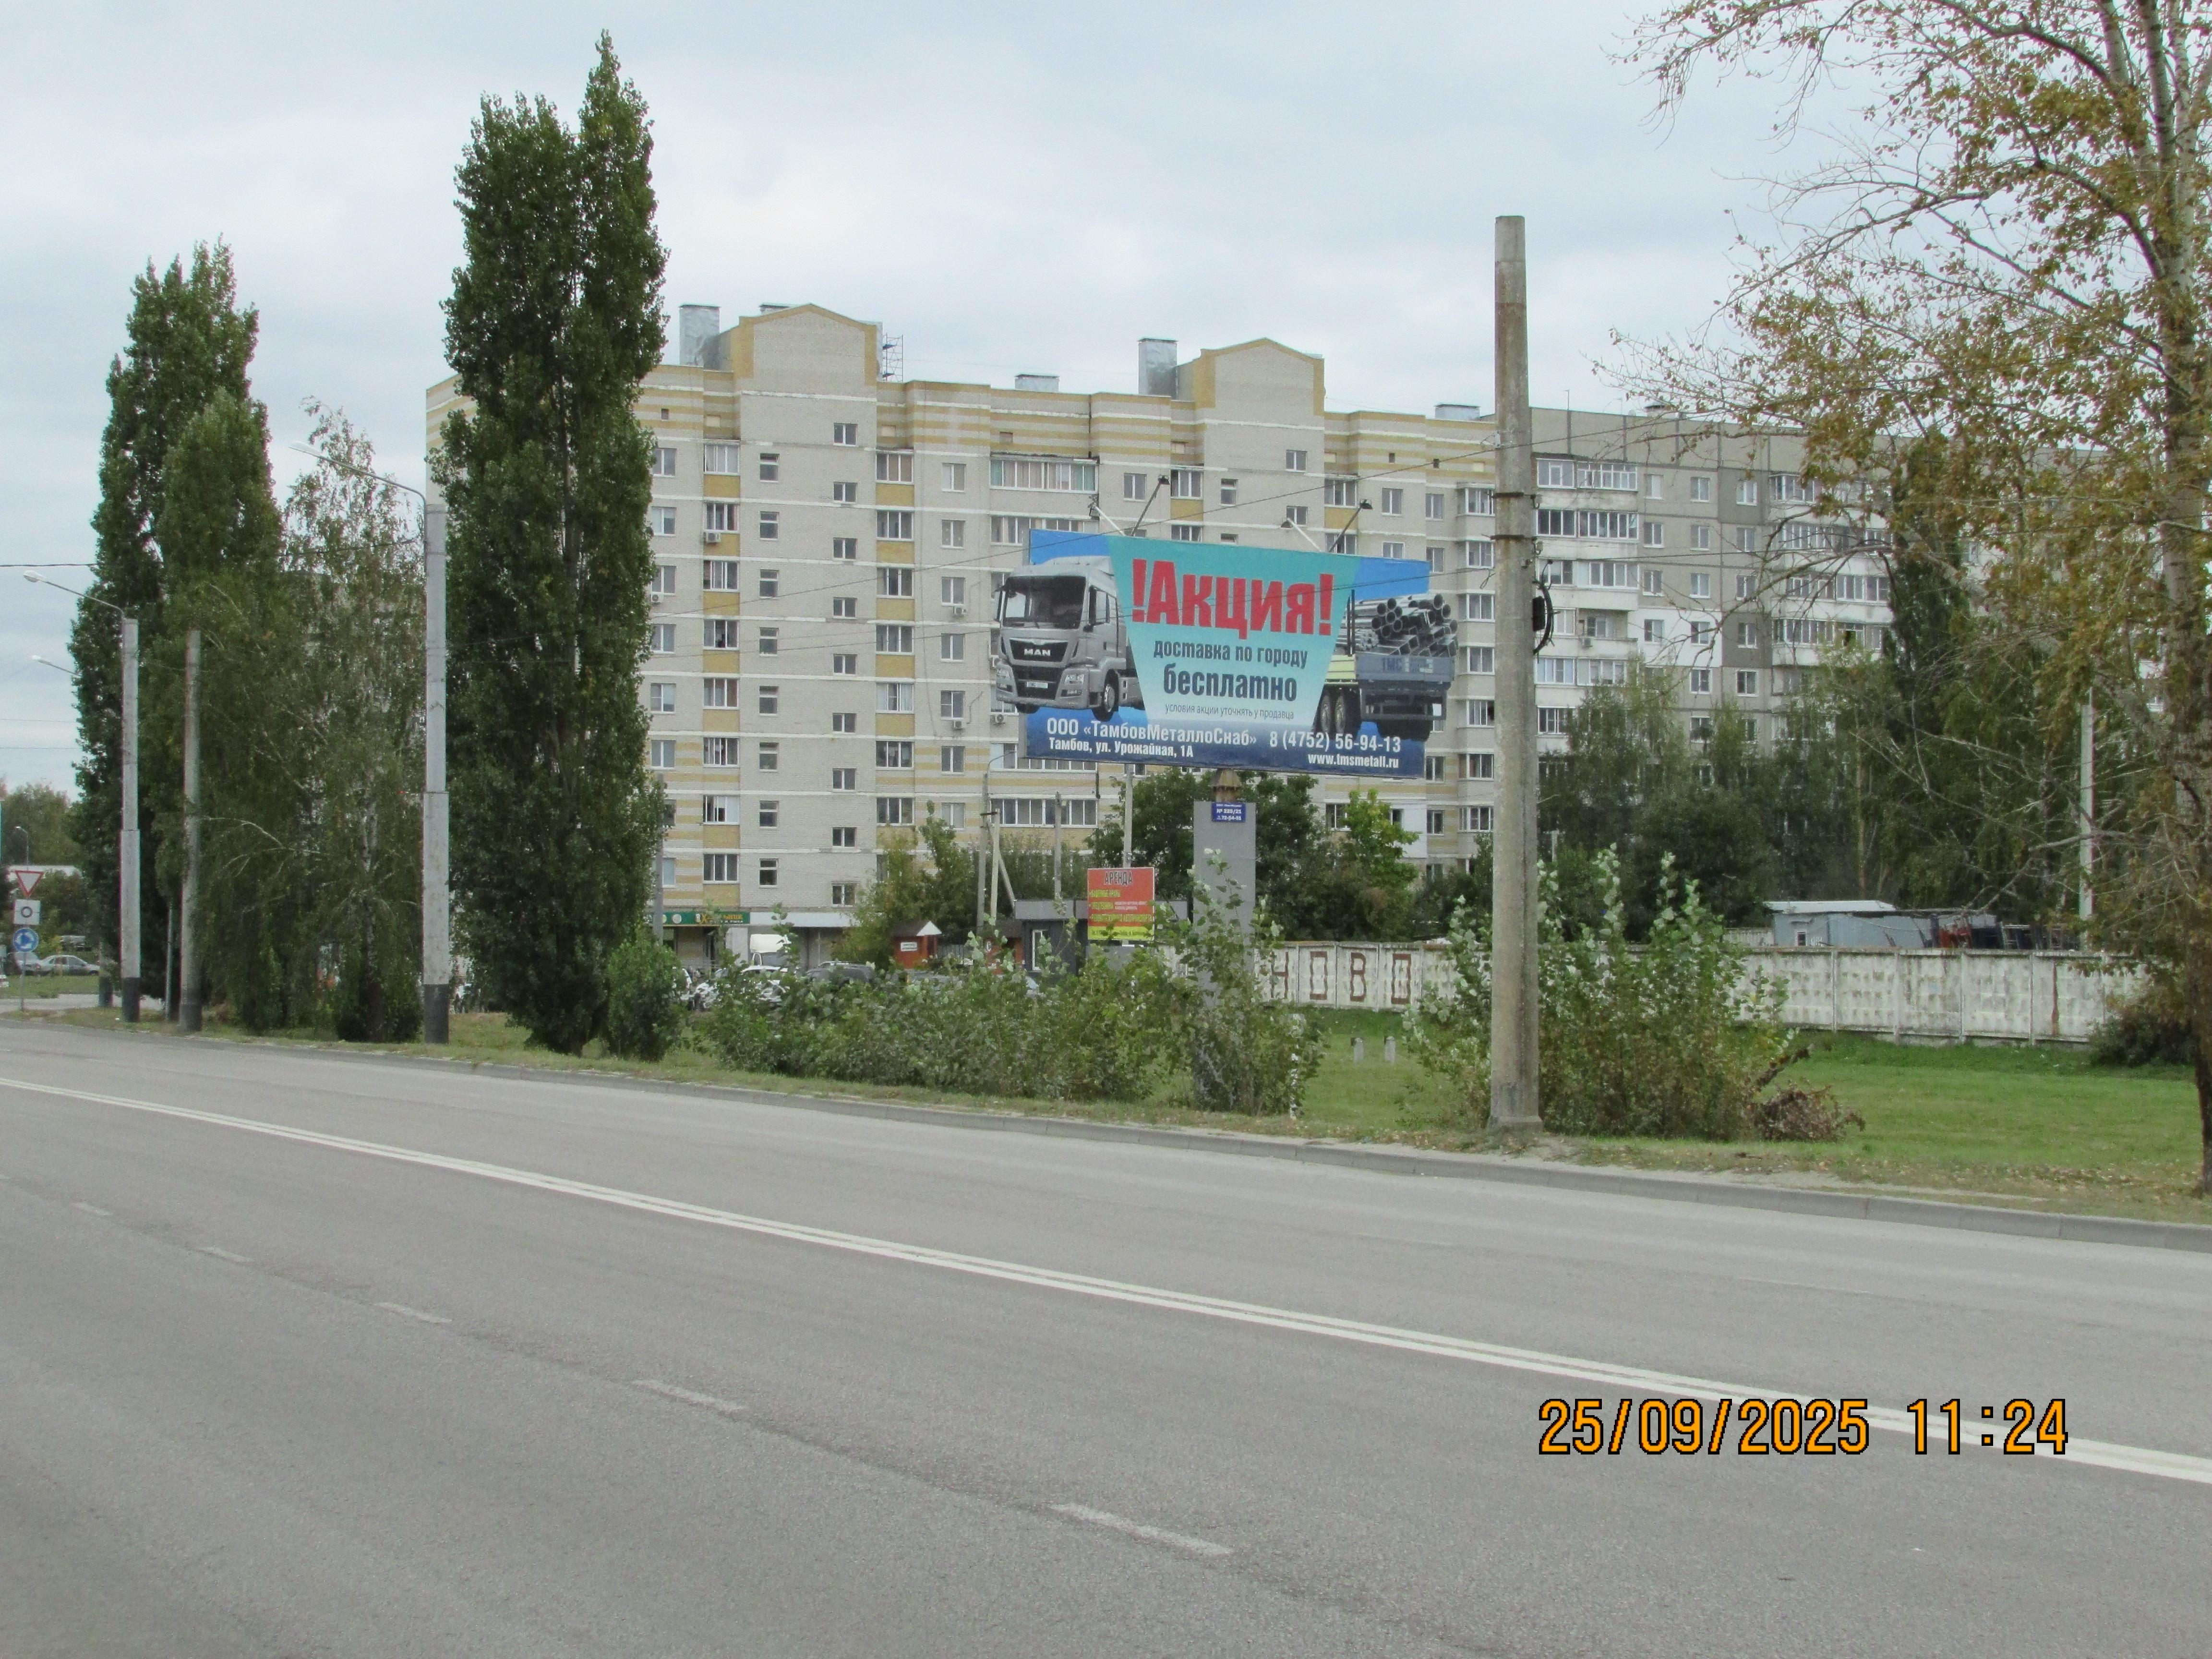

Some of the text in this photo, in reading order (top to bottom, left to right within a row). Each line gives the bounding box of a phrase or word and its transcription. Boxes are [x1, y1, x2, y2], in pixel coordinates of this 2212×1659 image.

[1132, 558, 1334, 639] !Акция!
[1154, 640, 1308, 670] доставка по городу
[1163, 662, 1297, 701] бесплатно
[1166, 703, 1294, 720] условия акции уточнять у продавца
[1047, 718, 1257, 746] ООО «ТамбовМеталлоСнаб»
[1269, 730, 1401, 753] 8 (4752) 56-94-13
[1049, 737, 1193, 757] Тамбов, ул. Урожайная, 1А
[1308, 753, 1399, 768] www.tmsmetall.ru
[1104, 871, 1133, 887] АРЕНДА
